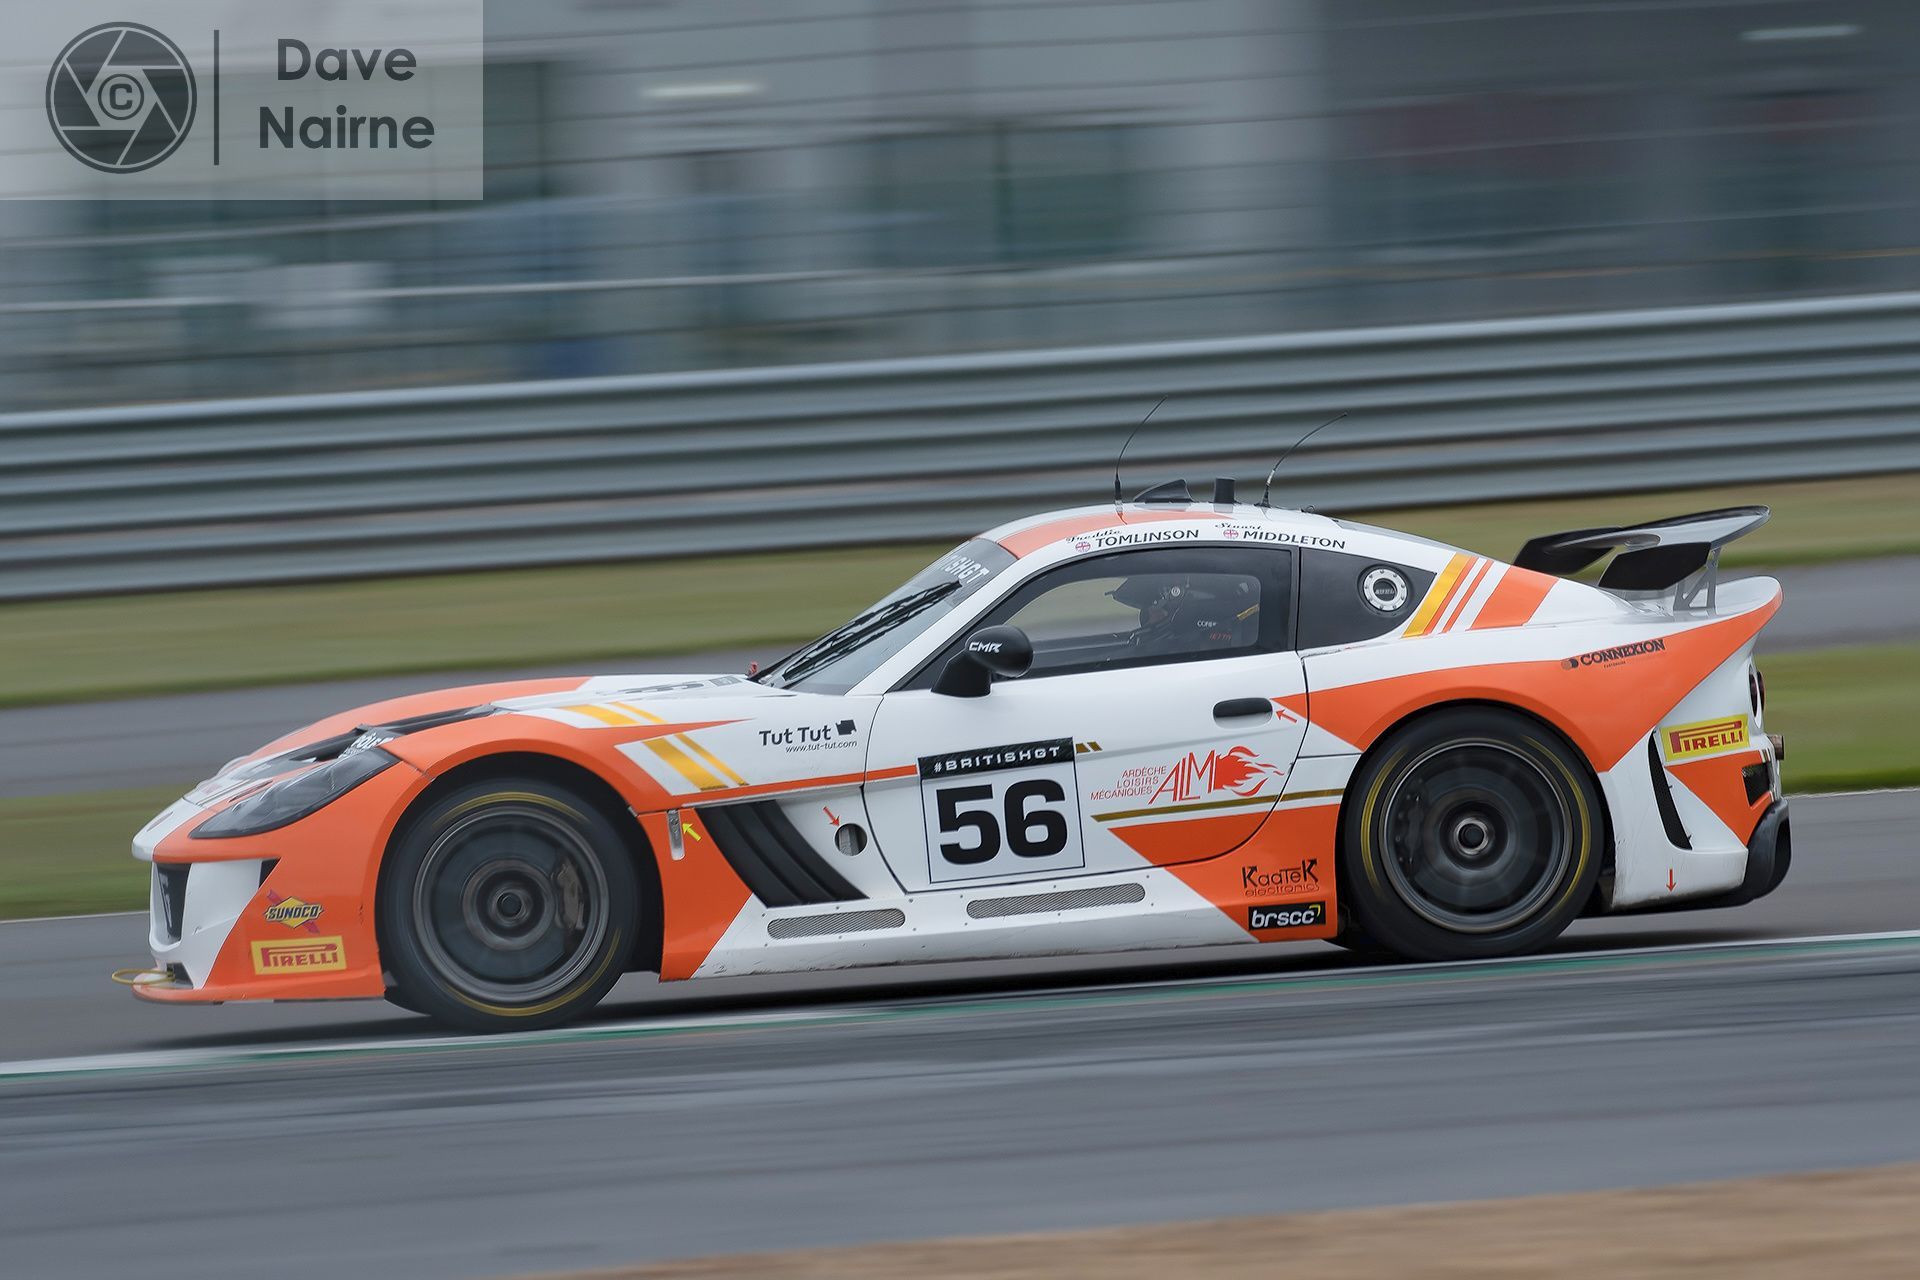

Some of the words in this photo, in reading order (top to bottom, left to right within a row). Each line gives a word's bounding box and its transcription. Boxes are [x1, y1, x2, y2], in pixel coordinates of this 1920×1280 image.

[1096, 529, 1199, 547] TOMLINSON
[1243, 530, 1346, 549] MIDDLETON
[968, 641, 1003, 653] CMR
[1580, 638, 1666, 666] CONNEXION
[759, 728, 794, 746] Tut
[797, 724, 831, 743] Tut
[1670, 720, 1744, 753] PIRELLI
[785, 740, 858, 753] www.tut-tut.com
[933, 746, 1060, 773] #BRITISHGT
[1116, 776, 1159, 789] LOISIRS
[936, 779, 1068, 865] 56
[268, 905, 320, 920] SUNOCO
[1251, 909, 1315, 928] brscc
[261, 943, 339, 967] PIRELLI
